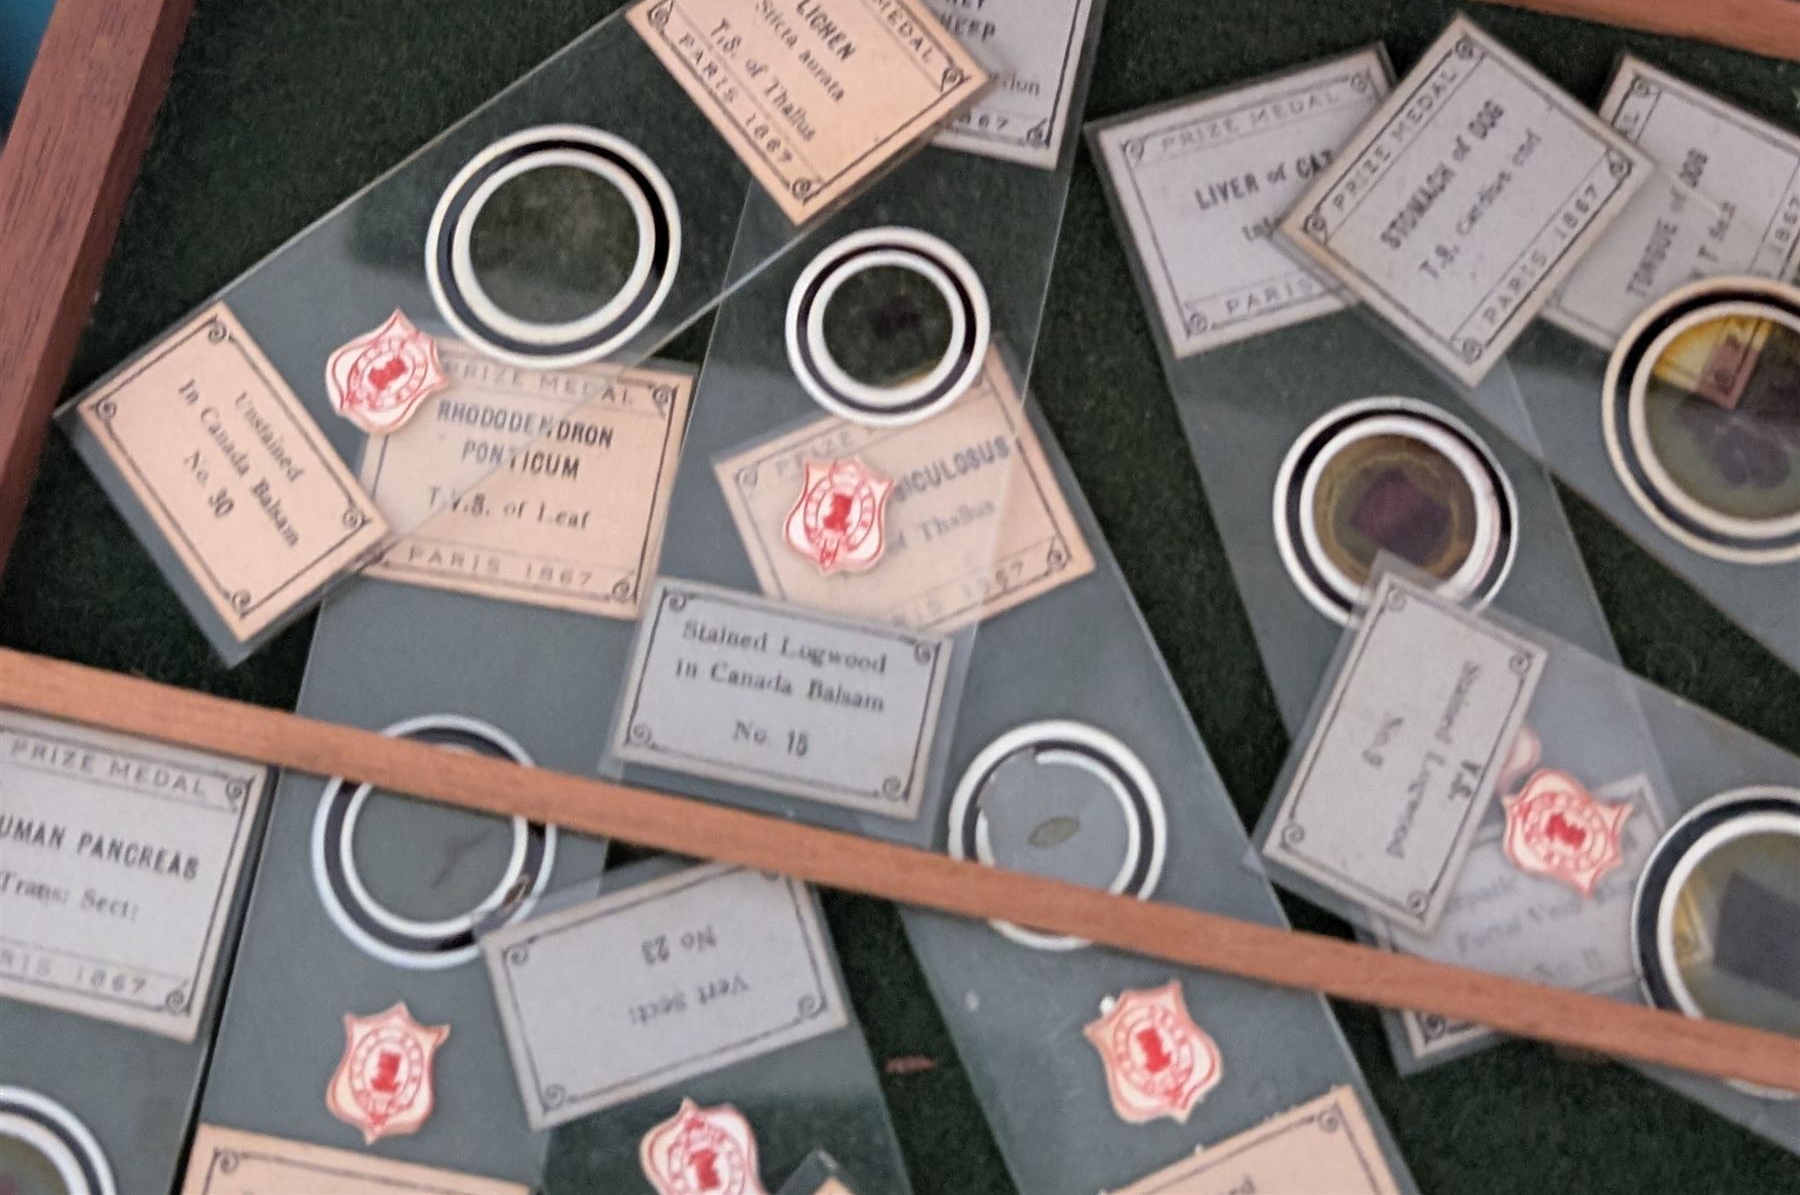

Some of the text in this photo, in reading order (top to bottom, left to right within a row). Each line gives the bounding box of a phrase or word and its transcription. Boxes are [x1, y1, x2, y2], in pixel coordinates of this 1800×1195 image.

[939, 13, 996, 42] HEEP
[678, 30, 794, 165] PARIS 1867
[1161, 89, 1338, 153] PRIZE MEDAL
[1332, 68, 1458, 213] PRIZE MEDAL
[1193, 174, 1261, 211] LIVER
[1266, 161, 1288, 184] of
[1379, 161, 1456, 250] STOMACH
[1481, 183, 1599, 327] PARIS 1867
[1226, 278, 1315, 314] PARIS
[538, 372, 635, 405] MEDAL
[233, 390, 306, 484] Unstained
[437, 400, 615, 450] RHODODENDRON
[177, 378, 301, 550] In Canada Balsam
[461, 438, 582, 482] PONTICUM
[207, 486, 236, 520] 30
[502, 498, 528, 520] of
[536, 501, 592, 531] Leaf
[407, 544, 594, 587] PARIS 1867
[681, 619, 887, 675] Stained Logwood
[674, 657, 885, 713] In Canada Balsam
[11, 739, 208, 797] PRIZE MEDAL
[0, 814, 201, 882] UMAN PANCREAS
[641, 934, 671, 967] 23
[75, 967, 147, 994] 1867
